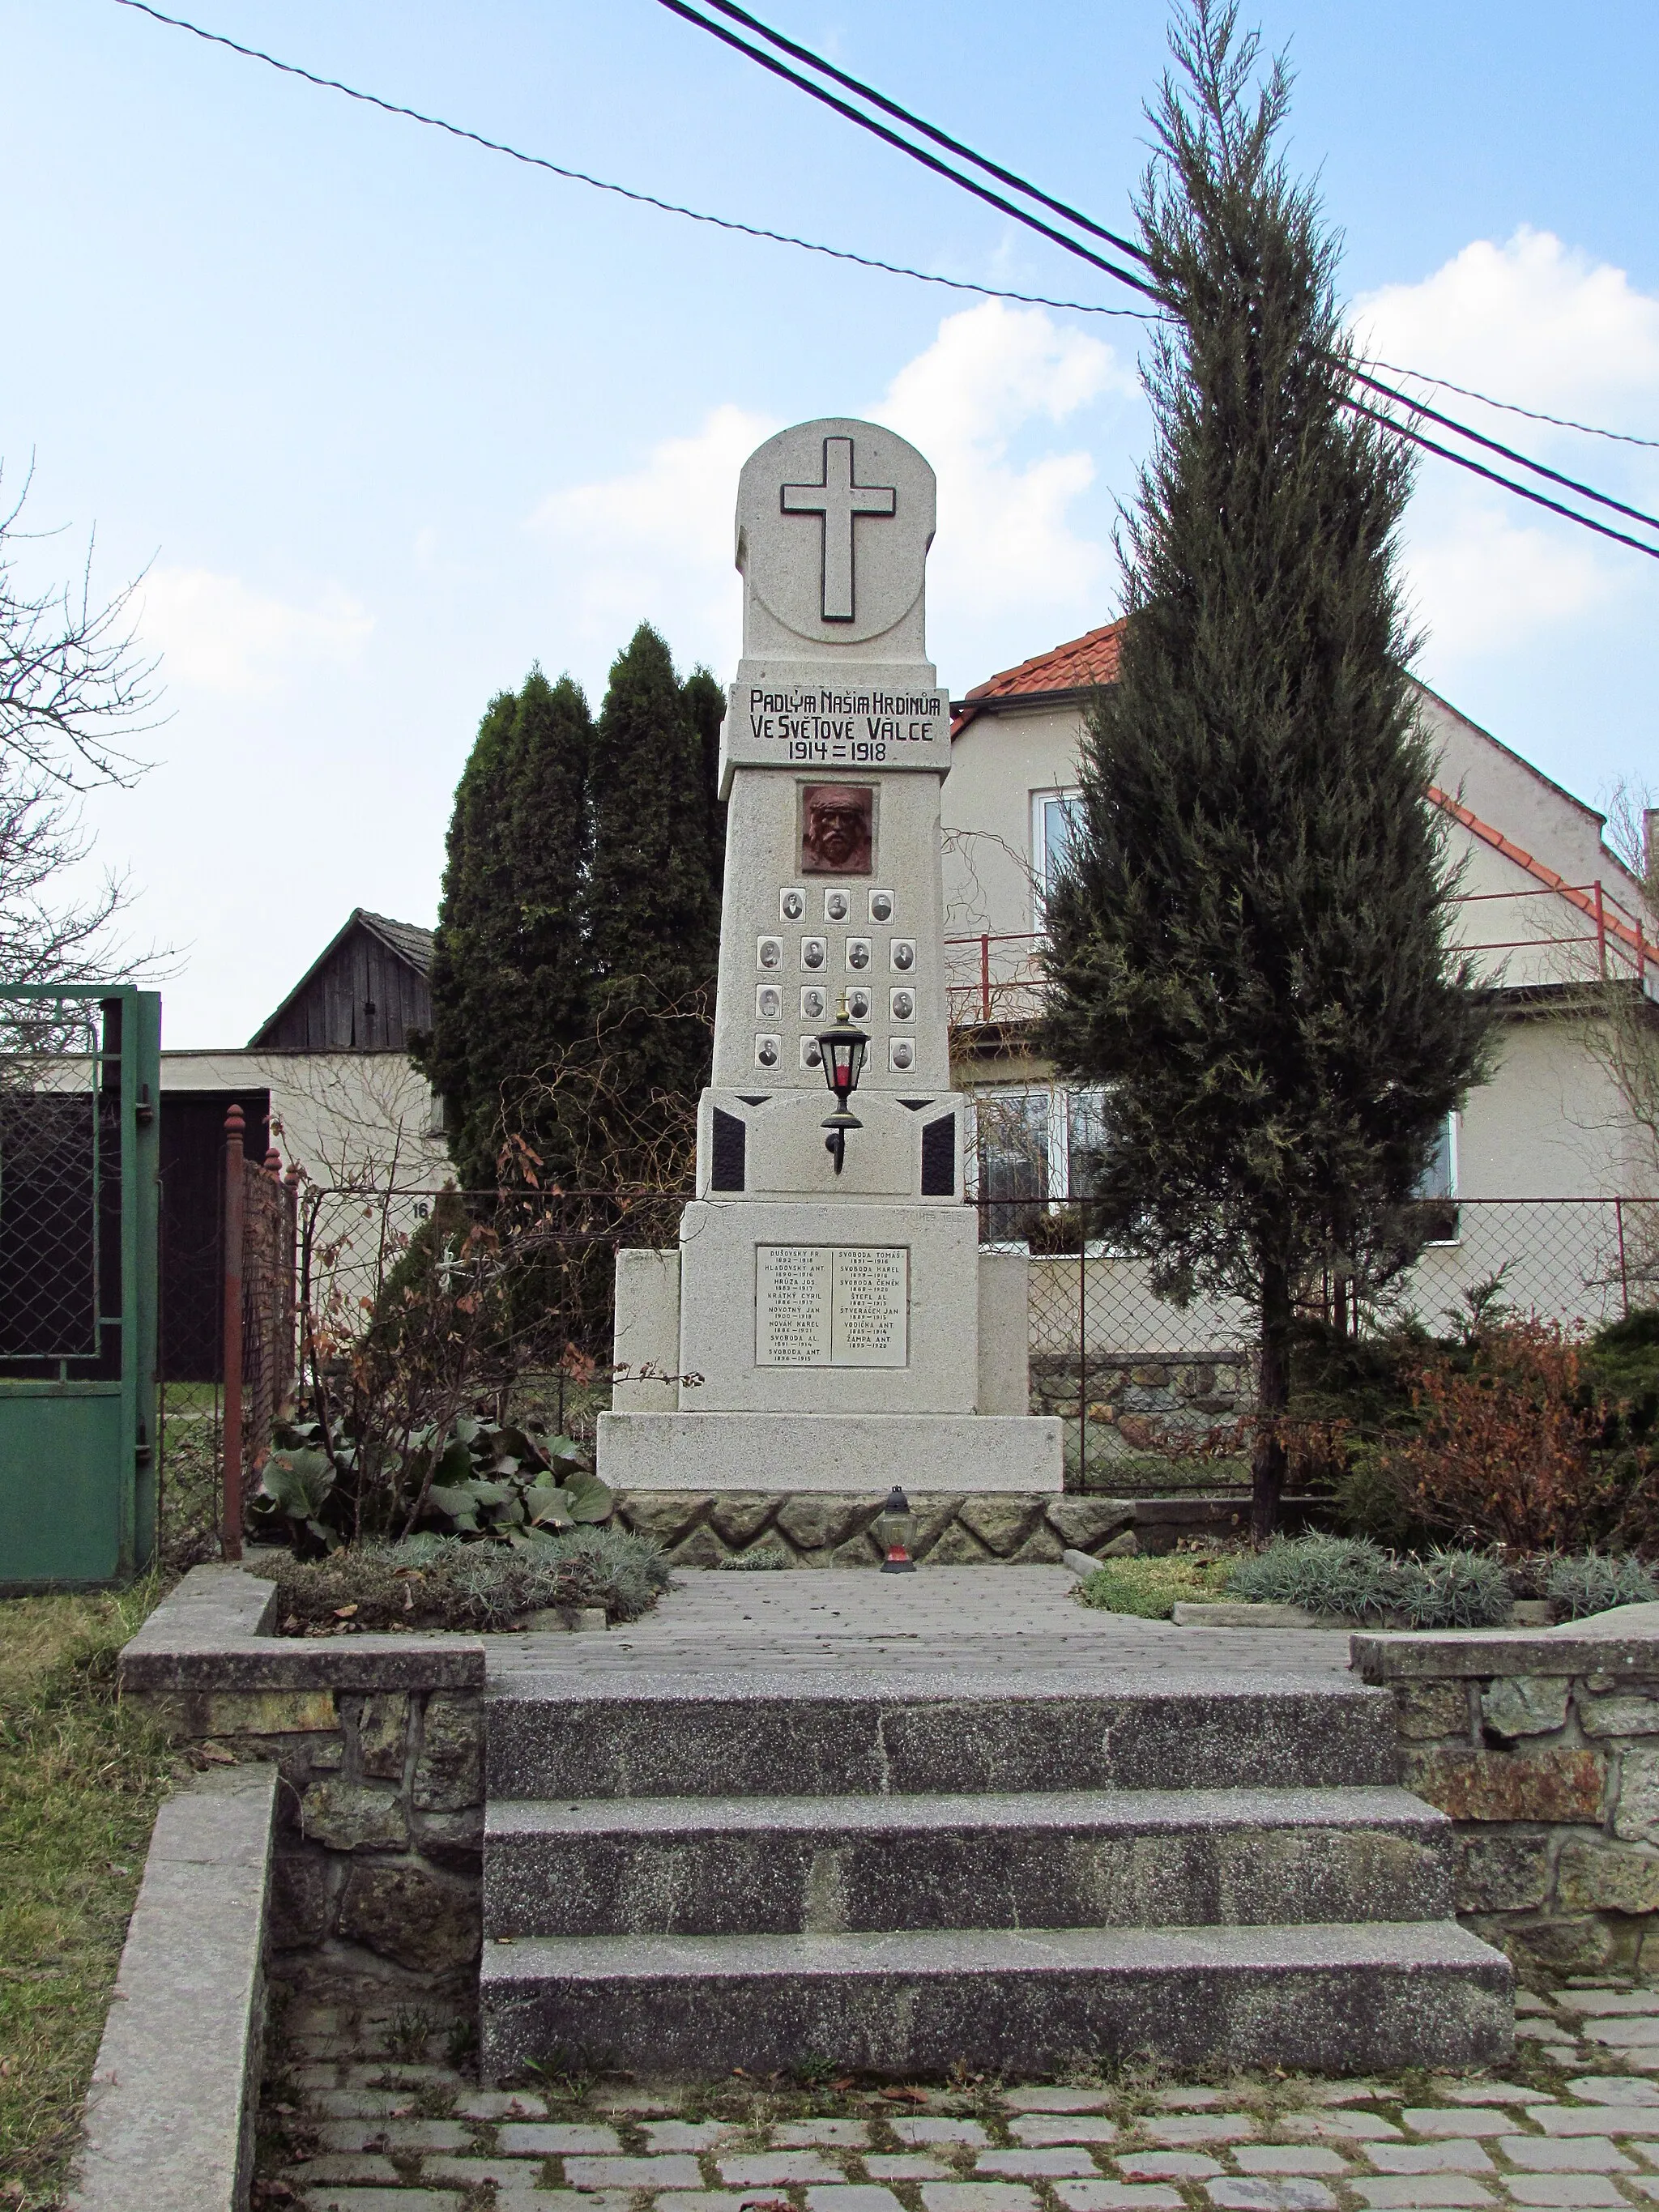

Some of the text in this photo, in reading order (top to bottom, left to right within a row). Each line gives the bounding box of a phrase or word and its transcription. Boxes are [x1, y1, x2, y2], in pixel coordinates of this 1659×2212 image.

[750, 714, 774, 739] VE
[867, 717, 933, 741] VÁLCE
[413, 1202, 428, 1219] 16
